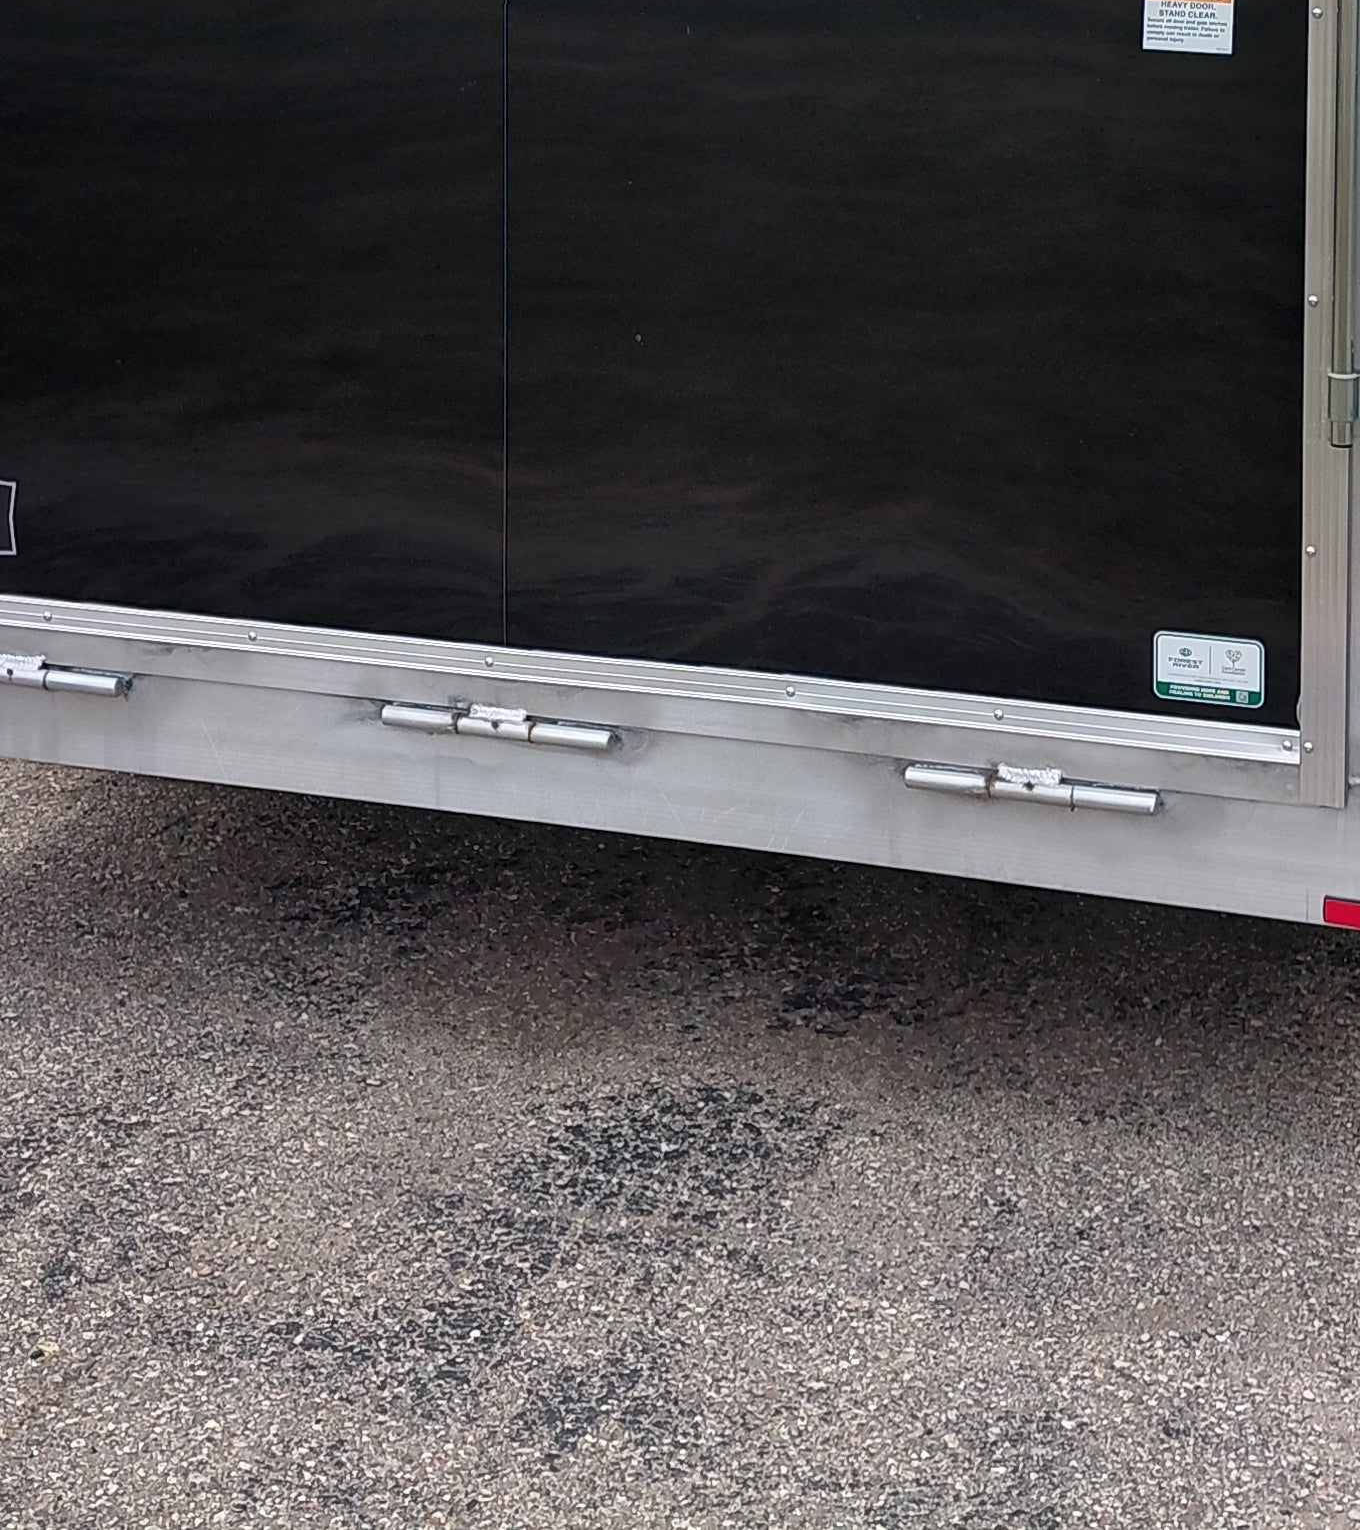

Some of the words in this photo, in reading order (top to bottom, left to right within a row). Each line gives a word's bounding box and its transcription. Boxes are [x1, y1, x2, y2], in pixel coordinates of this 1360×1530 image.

[1161, 1, 1188, 9] HEAVY
[1159, 9, 1186, 18] STAND
[1168, 657, 1203, 666] FOREST
